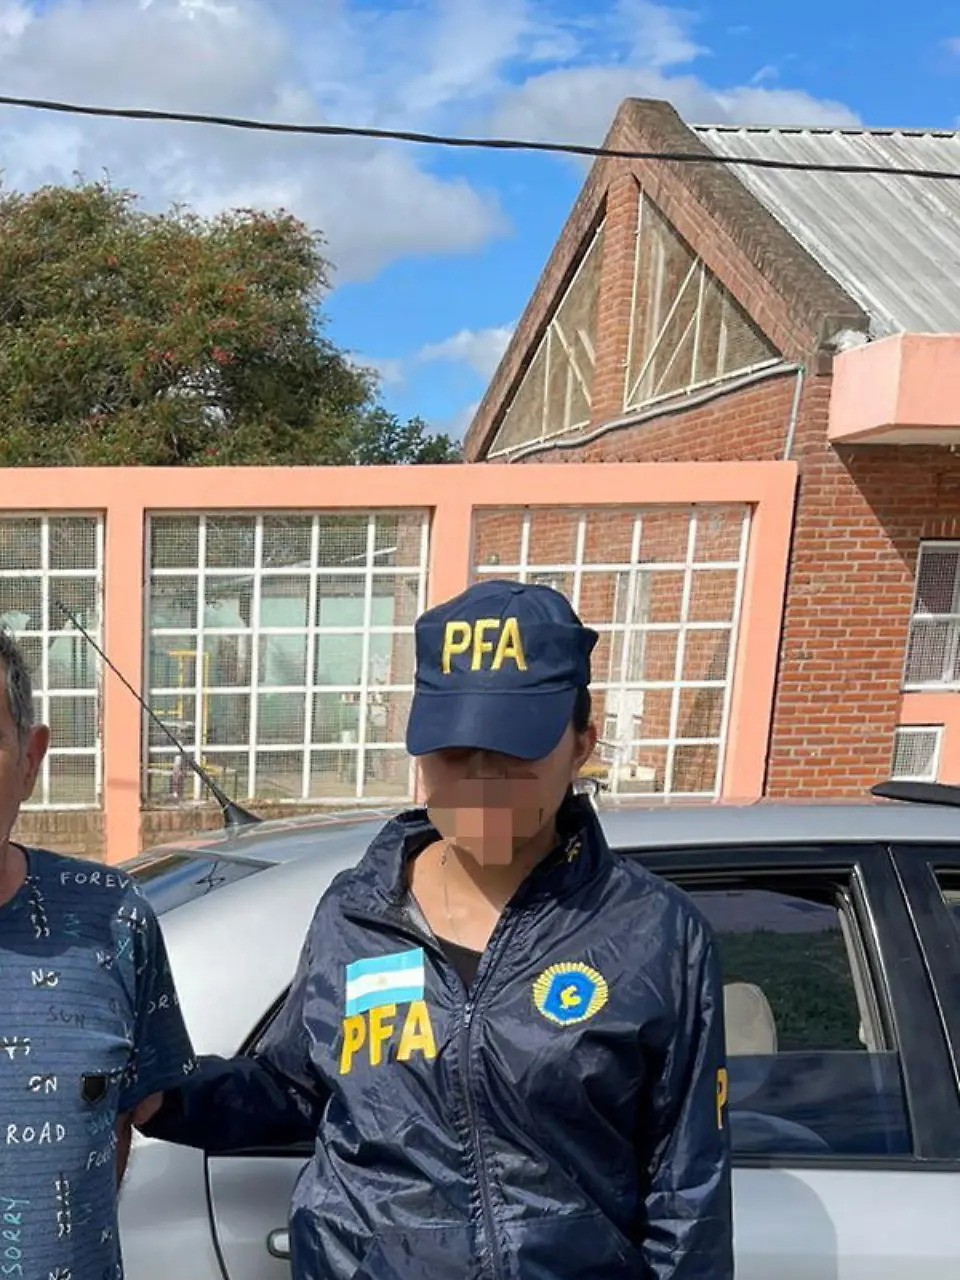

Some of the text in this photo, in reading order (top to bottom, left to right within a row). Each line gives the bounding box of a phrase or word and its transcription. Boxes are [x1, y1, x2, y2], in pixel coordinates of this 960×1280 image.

[442, 616, 528, 674] PFA
[30, 969, 61, 988] NO
[340, 999, 437, 1075] PFA
[6, 1122, 67, 1145] ROAD
[2, 1195, 32, 1278] SORRY
